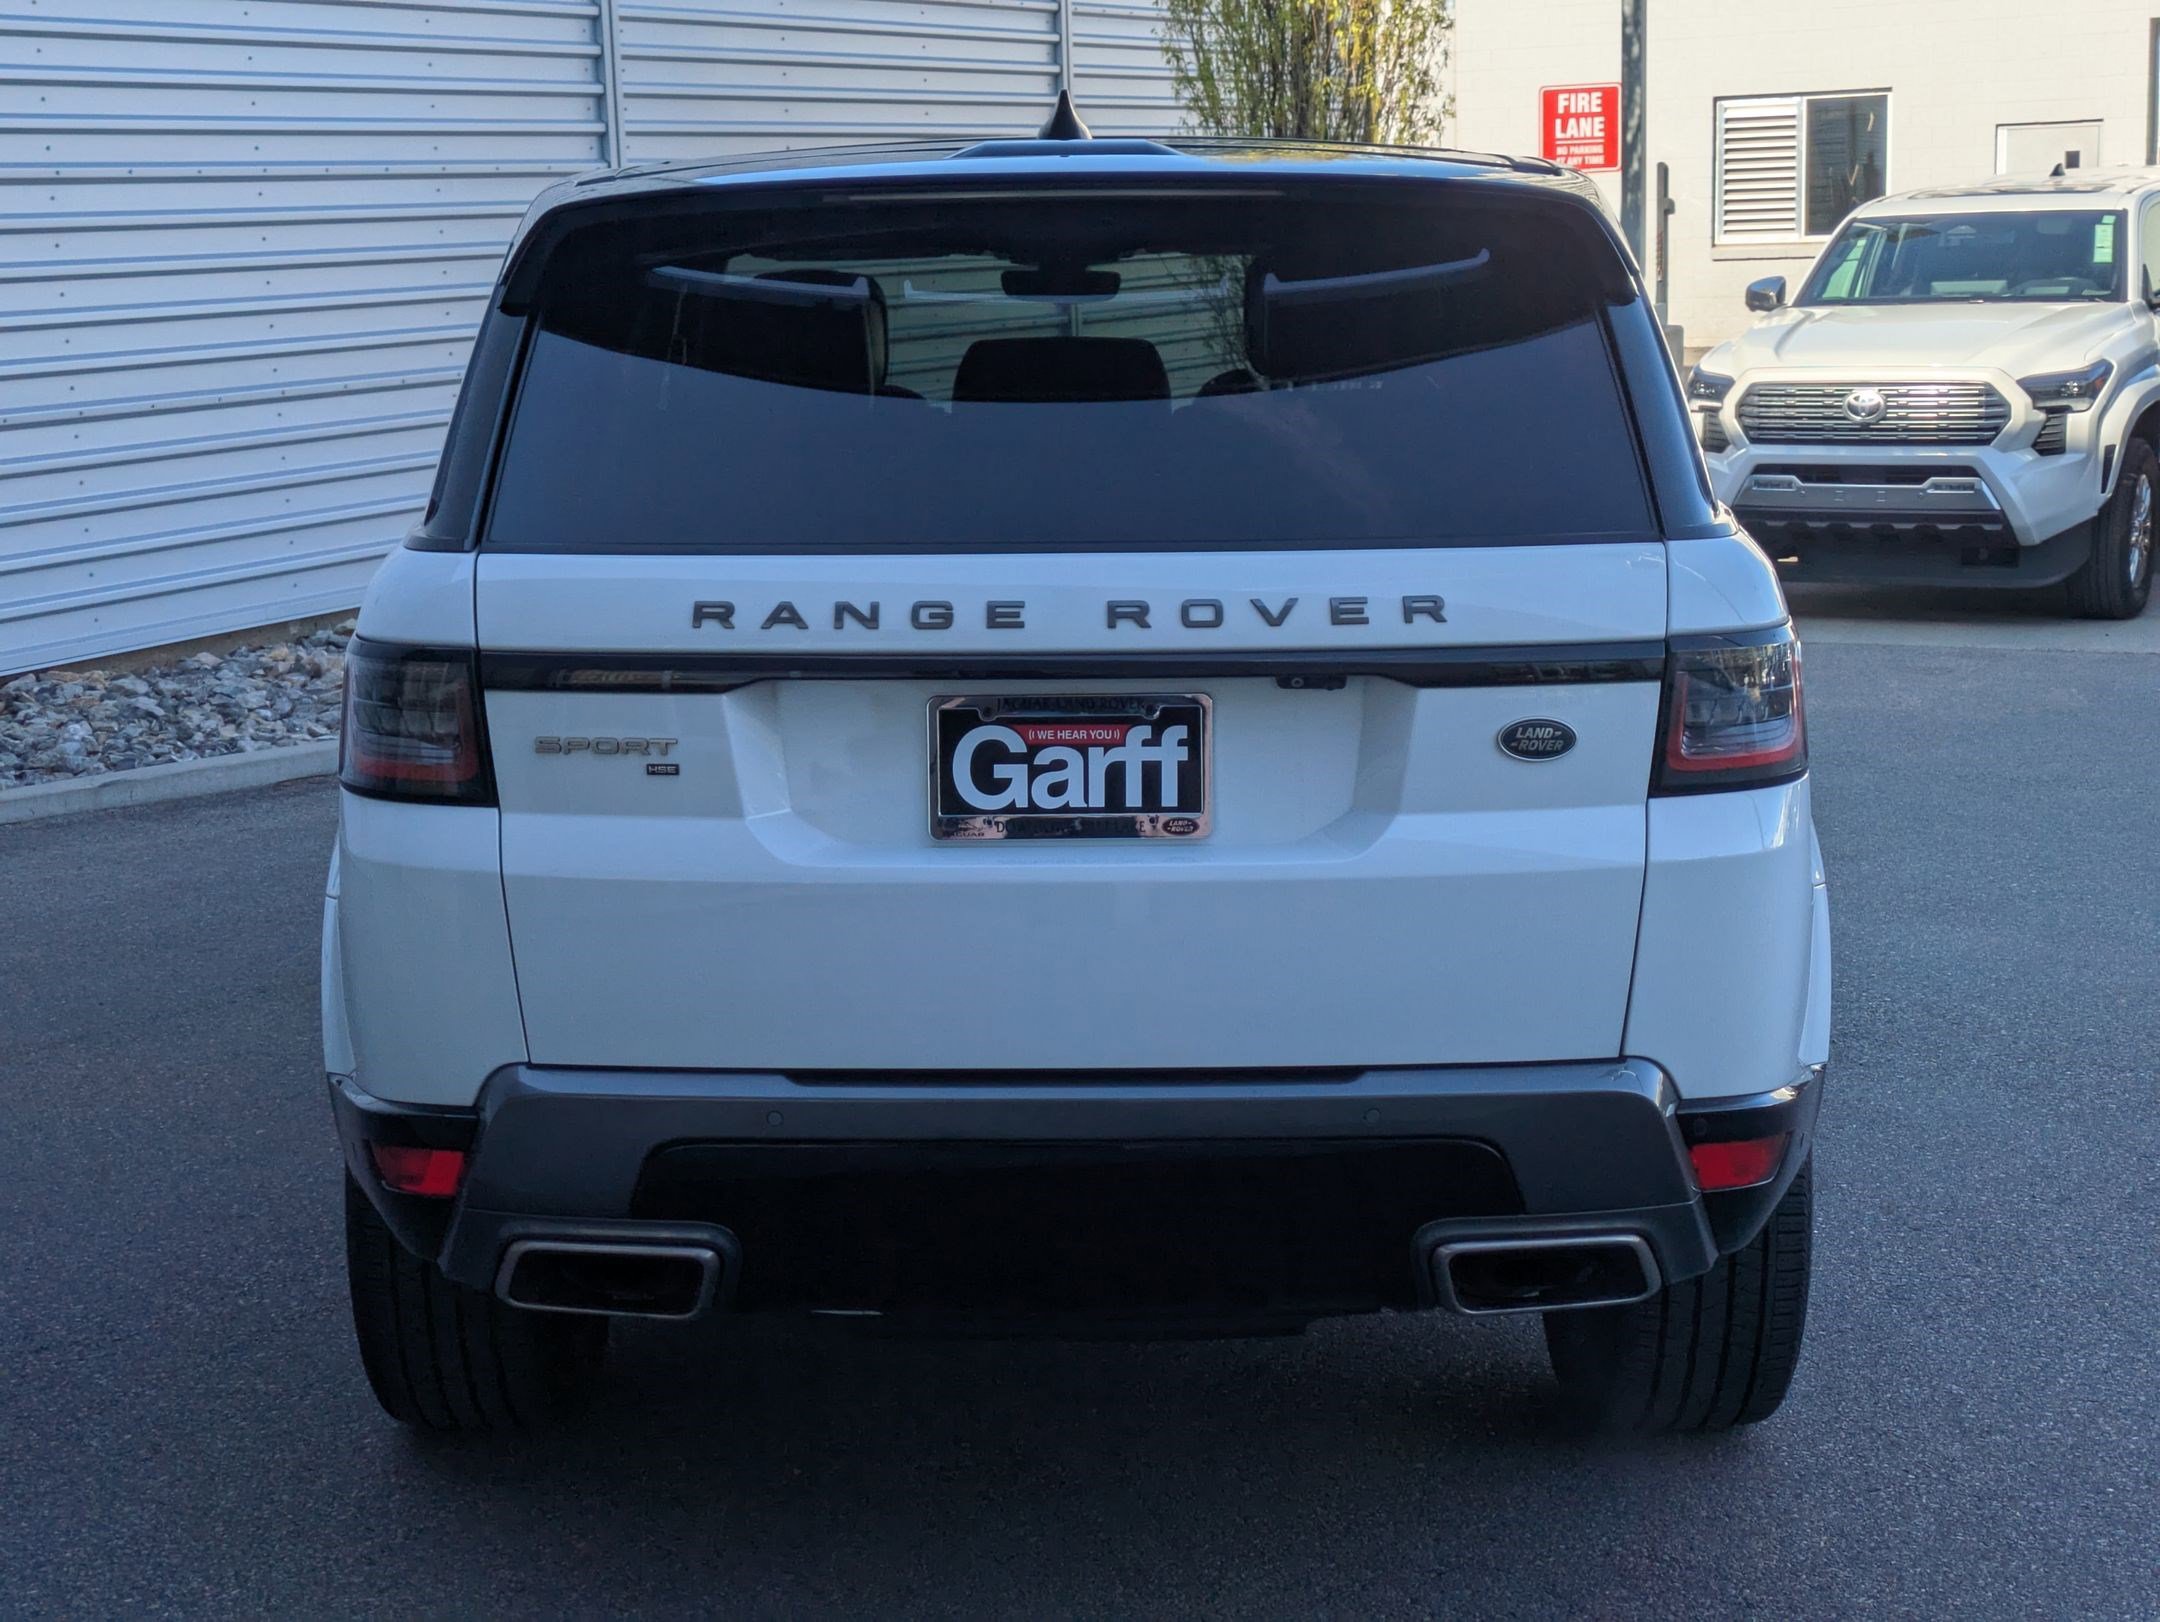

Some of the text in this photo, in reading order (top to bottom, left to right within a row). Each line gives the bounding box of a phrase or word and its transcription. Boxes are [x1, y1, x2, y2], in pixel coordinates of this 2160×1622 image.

[1557, 92, 1603, 115] FIRE
[1555, 116, 1605, 139] LANE
[692, 594, 1447, 630] RANGE ROVER
[534, 736, 679, 756] SPORT
[1037, 730, 1112, 740] WE HEAR YOU
[648, 765, 678, 774] HSE
[952, 725, 1189, 810] Garff
